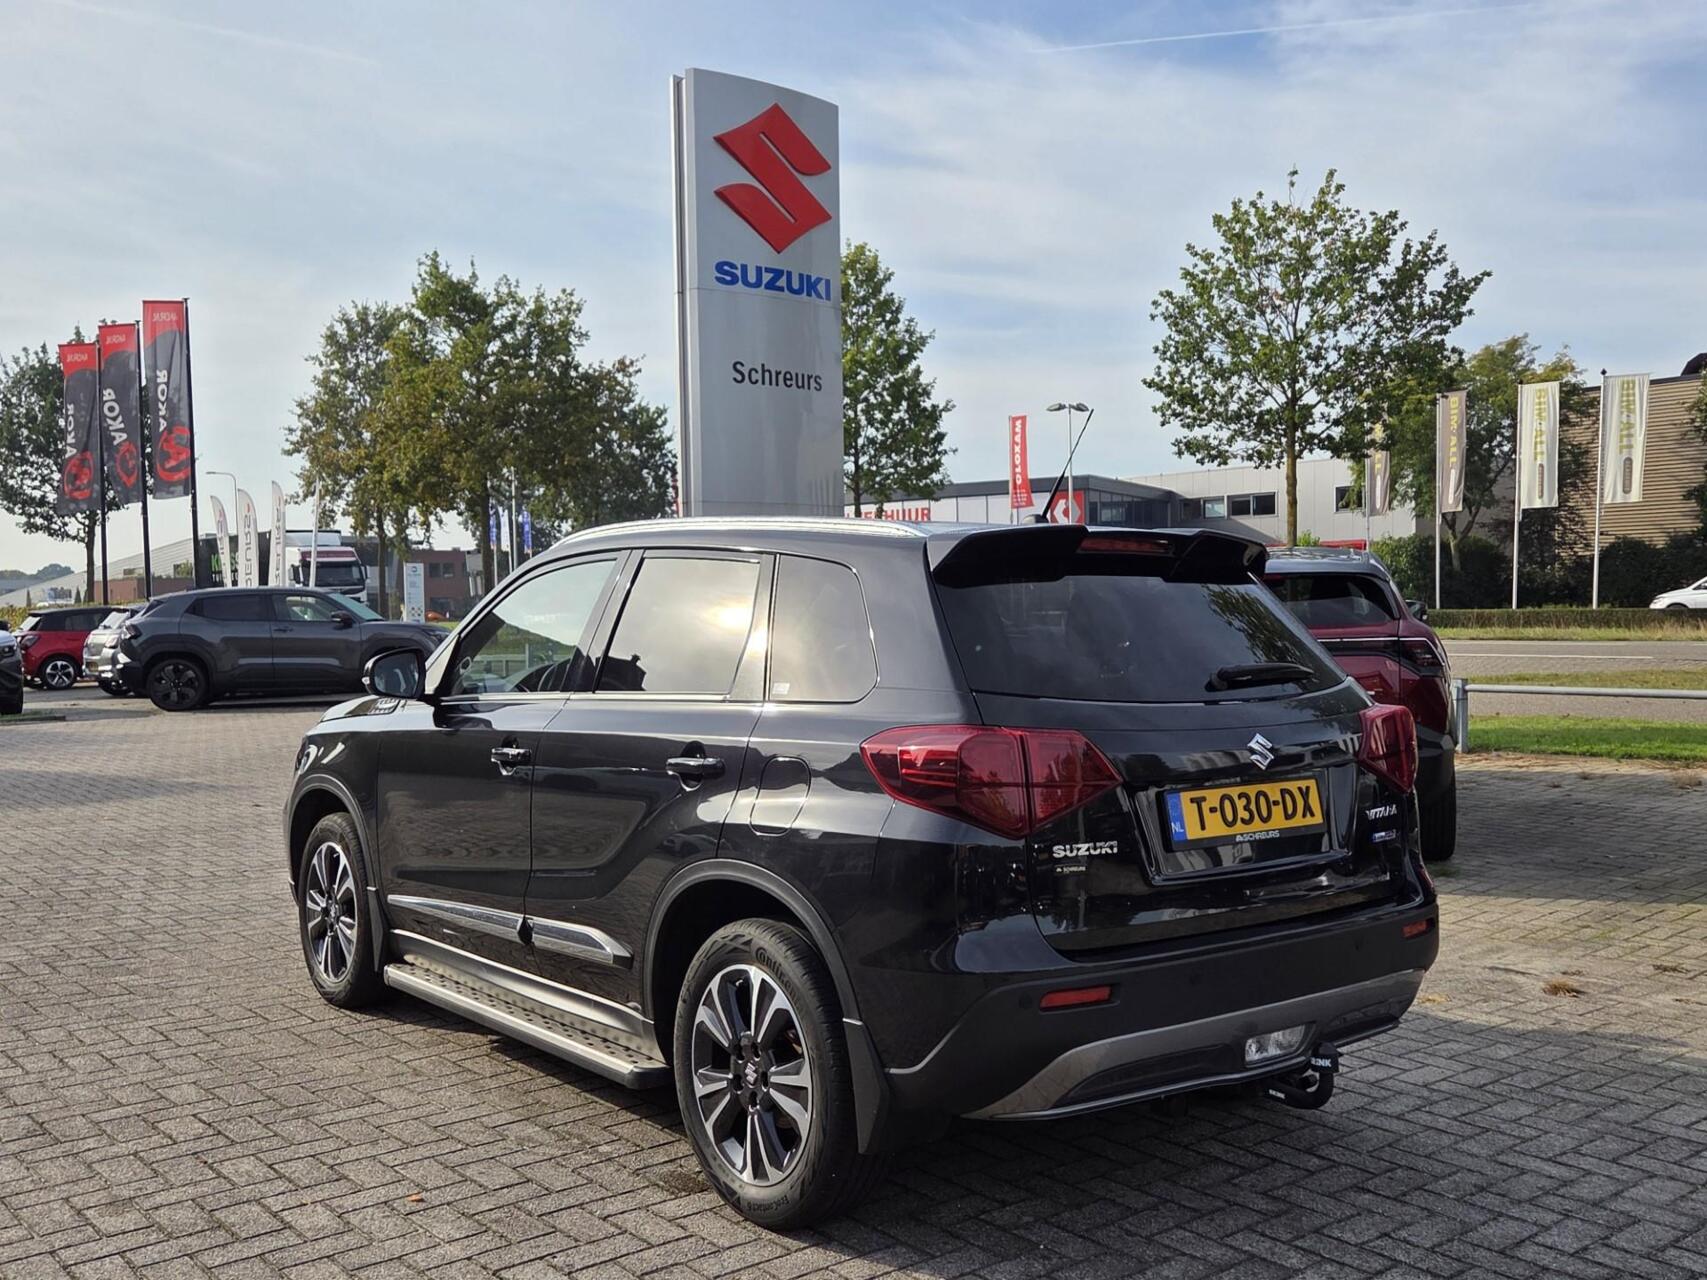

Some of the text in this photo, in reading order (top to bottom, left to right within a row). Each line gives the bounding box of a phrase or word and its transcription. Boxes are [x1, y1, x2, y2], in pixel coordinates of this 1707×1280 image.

[714, 260, 832, 301] SUZUKI
[732, 360, 823, 392] Schreurs
[1190, 785, 1315, 831] T-030-DX
[1171, 821, 1184, 833] NL
[1052, 840, 1118, 859] SUZUKI
